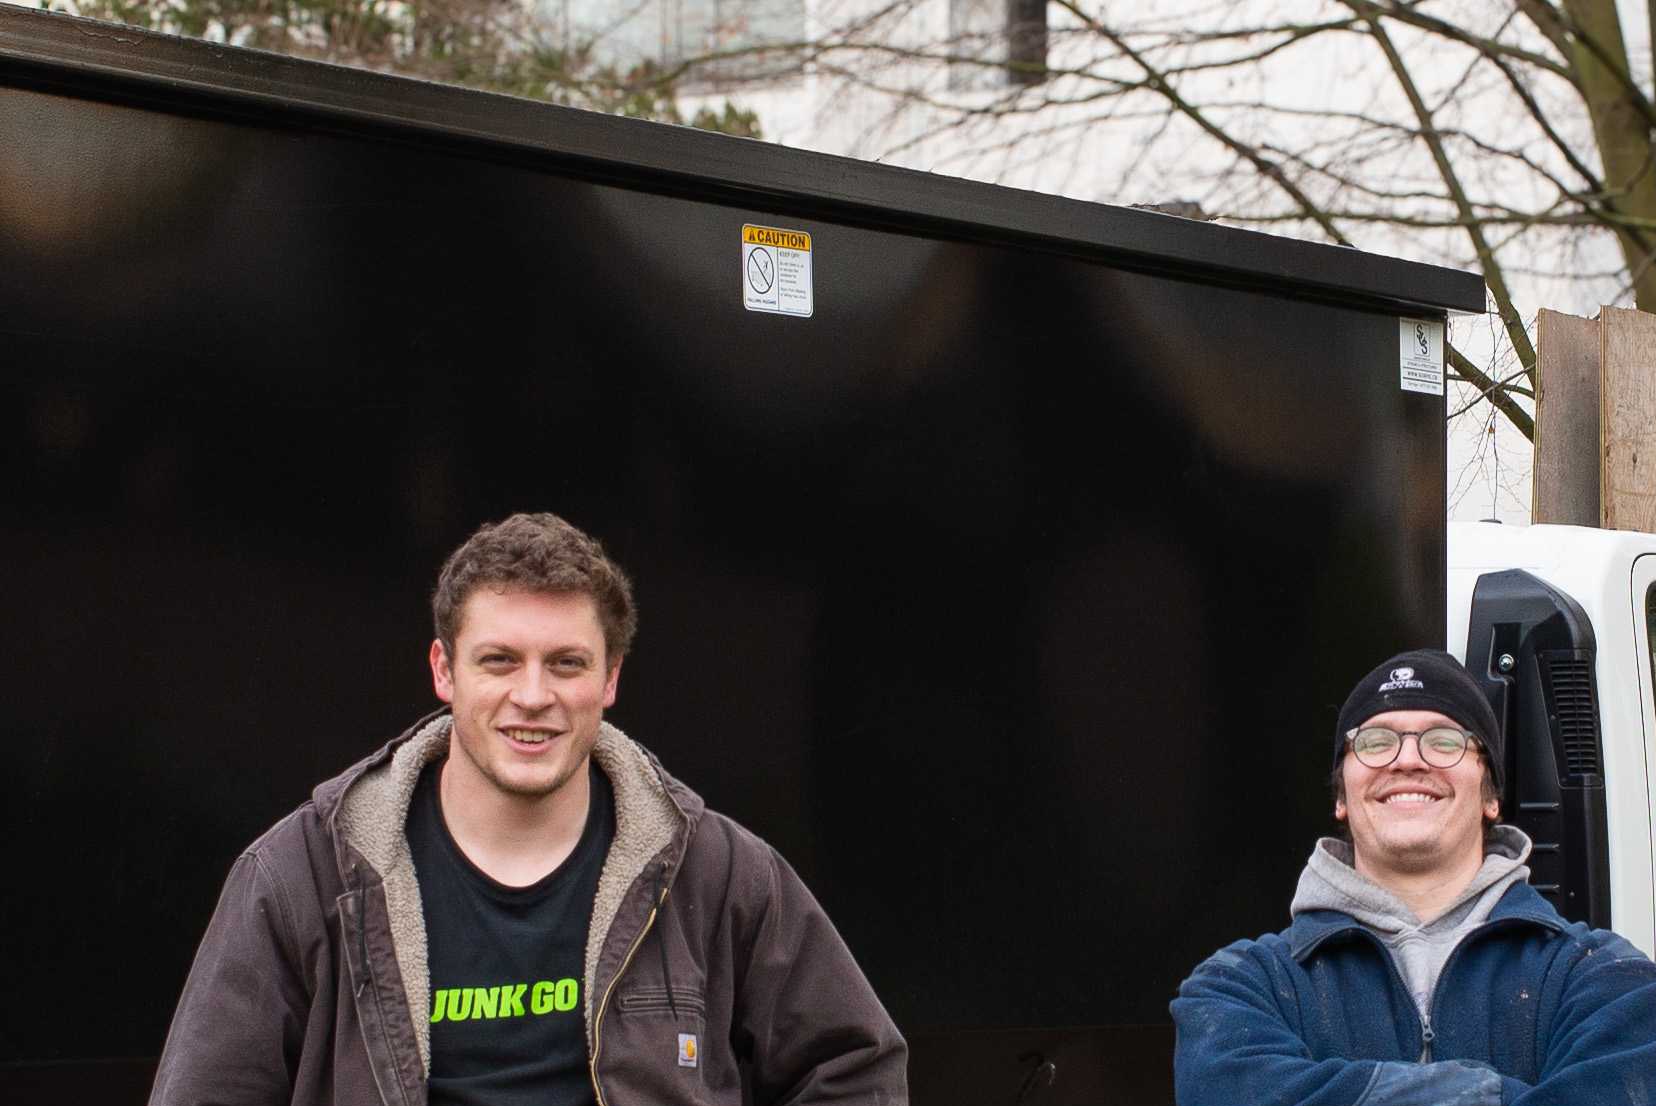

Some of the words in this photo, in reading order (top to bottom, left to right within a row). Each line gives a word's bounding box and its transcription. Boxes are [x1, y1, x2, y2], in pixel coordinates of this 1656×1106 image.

[757, 230, 806, 248] CAUTION
[430, 983, 529, 1023] JUNK
[530, 978, 579, 1015] GO
